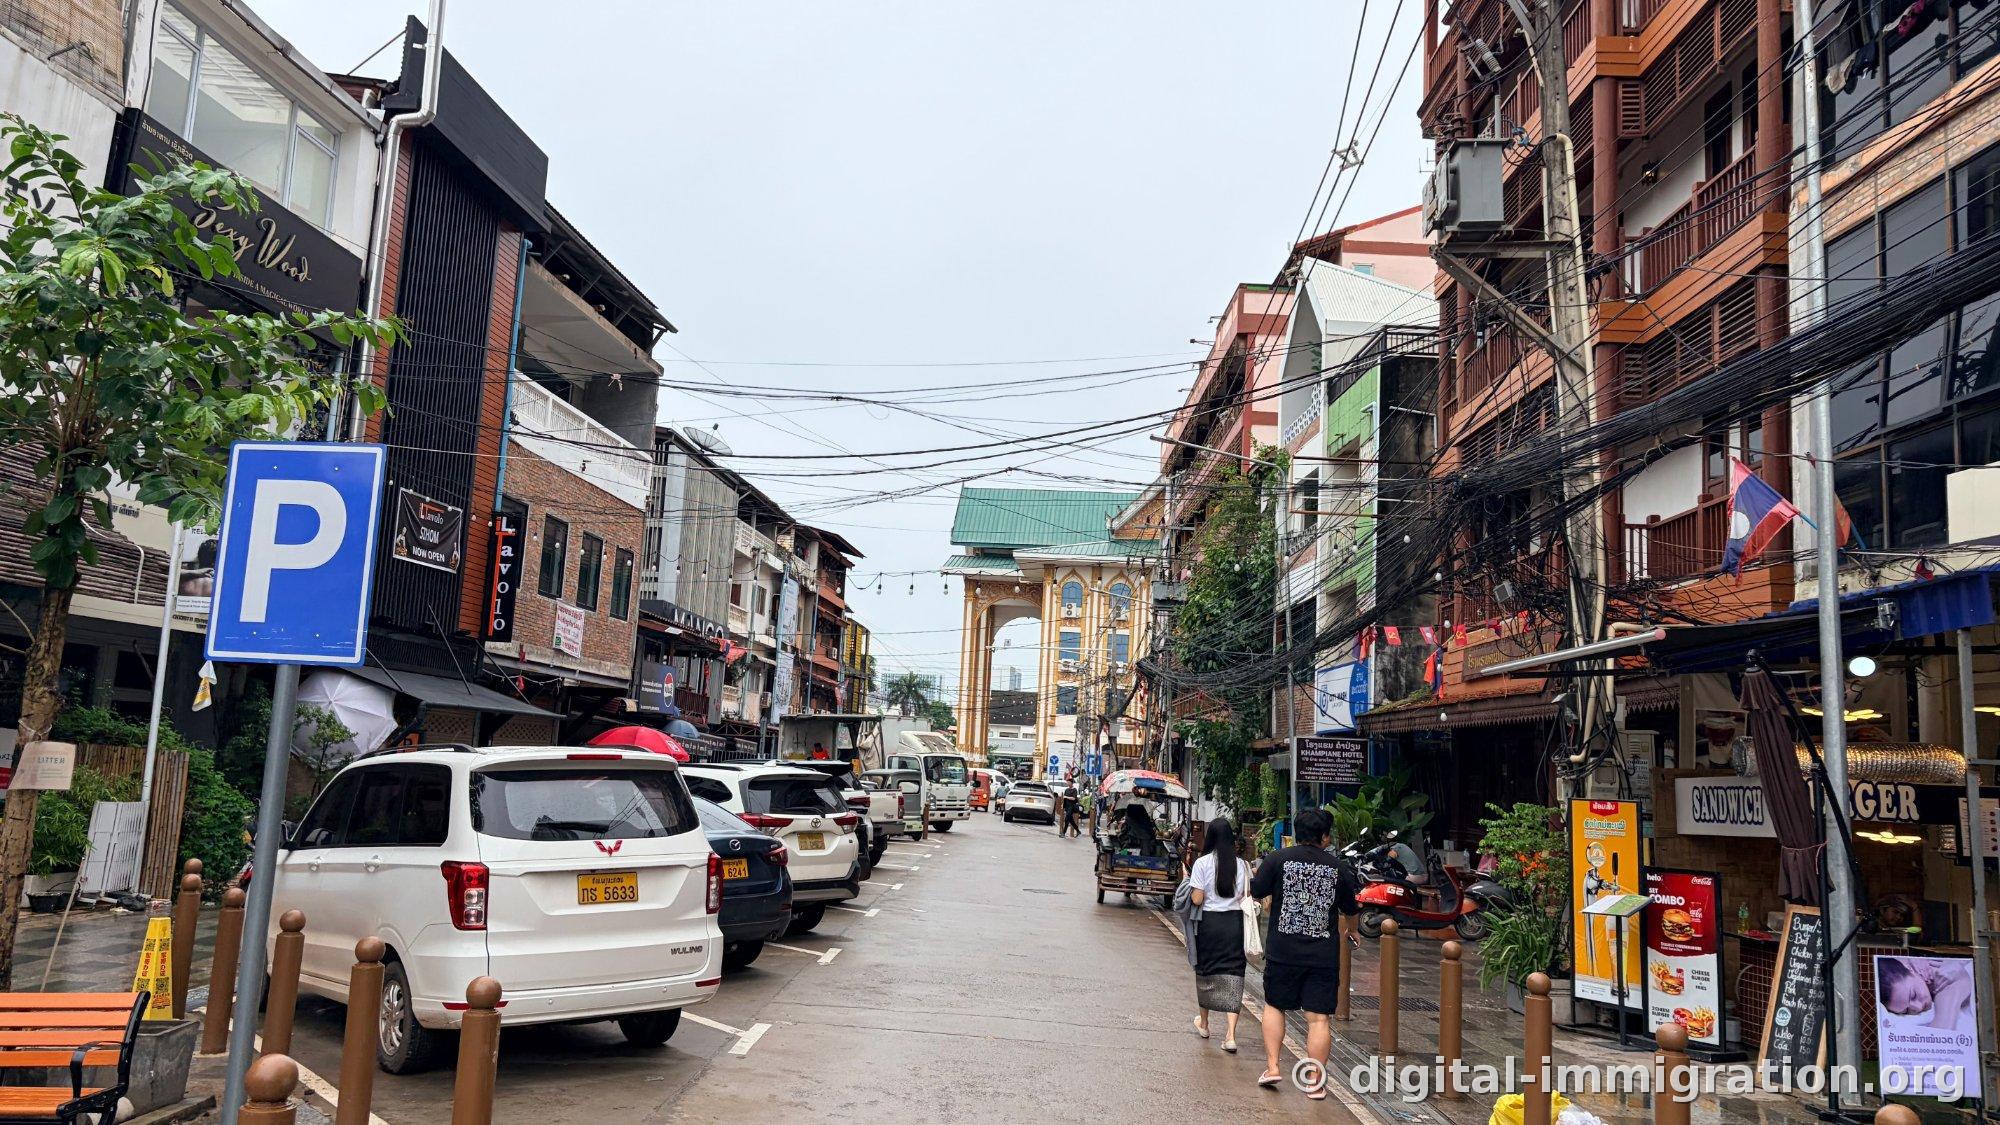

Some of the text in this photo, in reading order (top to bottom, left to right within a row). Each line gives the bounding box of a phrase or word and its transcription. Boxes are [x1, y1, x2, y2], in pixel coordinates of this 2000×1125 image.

[194, 190, 312, 283] Sexy Wood
[259, 287, 287, 307] MAGICAL
[240, 479, 347, 623] P
[412, 545, 445, 563] NOW OPEN
[1301, 750, 1364, 759] KHAMPIANE HOTEL
[38, 756, 65, 765] LITTER
[1692, 786, 1764, 825] SANDWICH
[729, 867, 747, 878] 6241
[1691, 876, 1712, 886] Coca-Cola
[604, 886, 635, 900] 5633
[1386, 886, 1404, 896] G2
[670, 945, 703, 955] WULING
[1691, 969, 1710, 977] CHEESE
